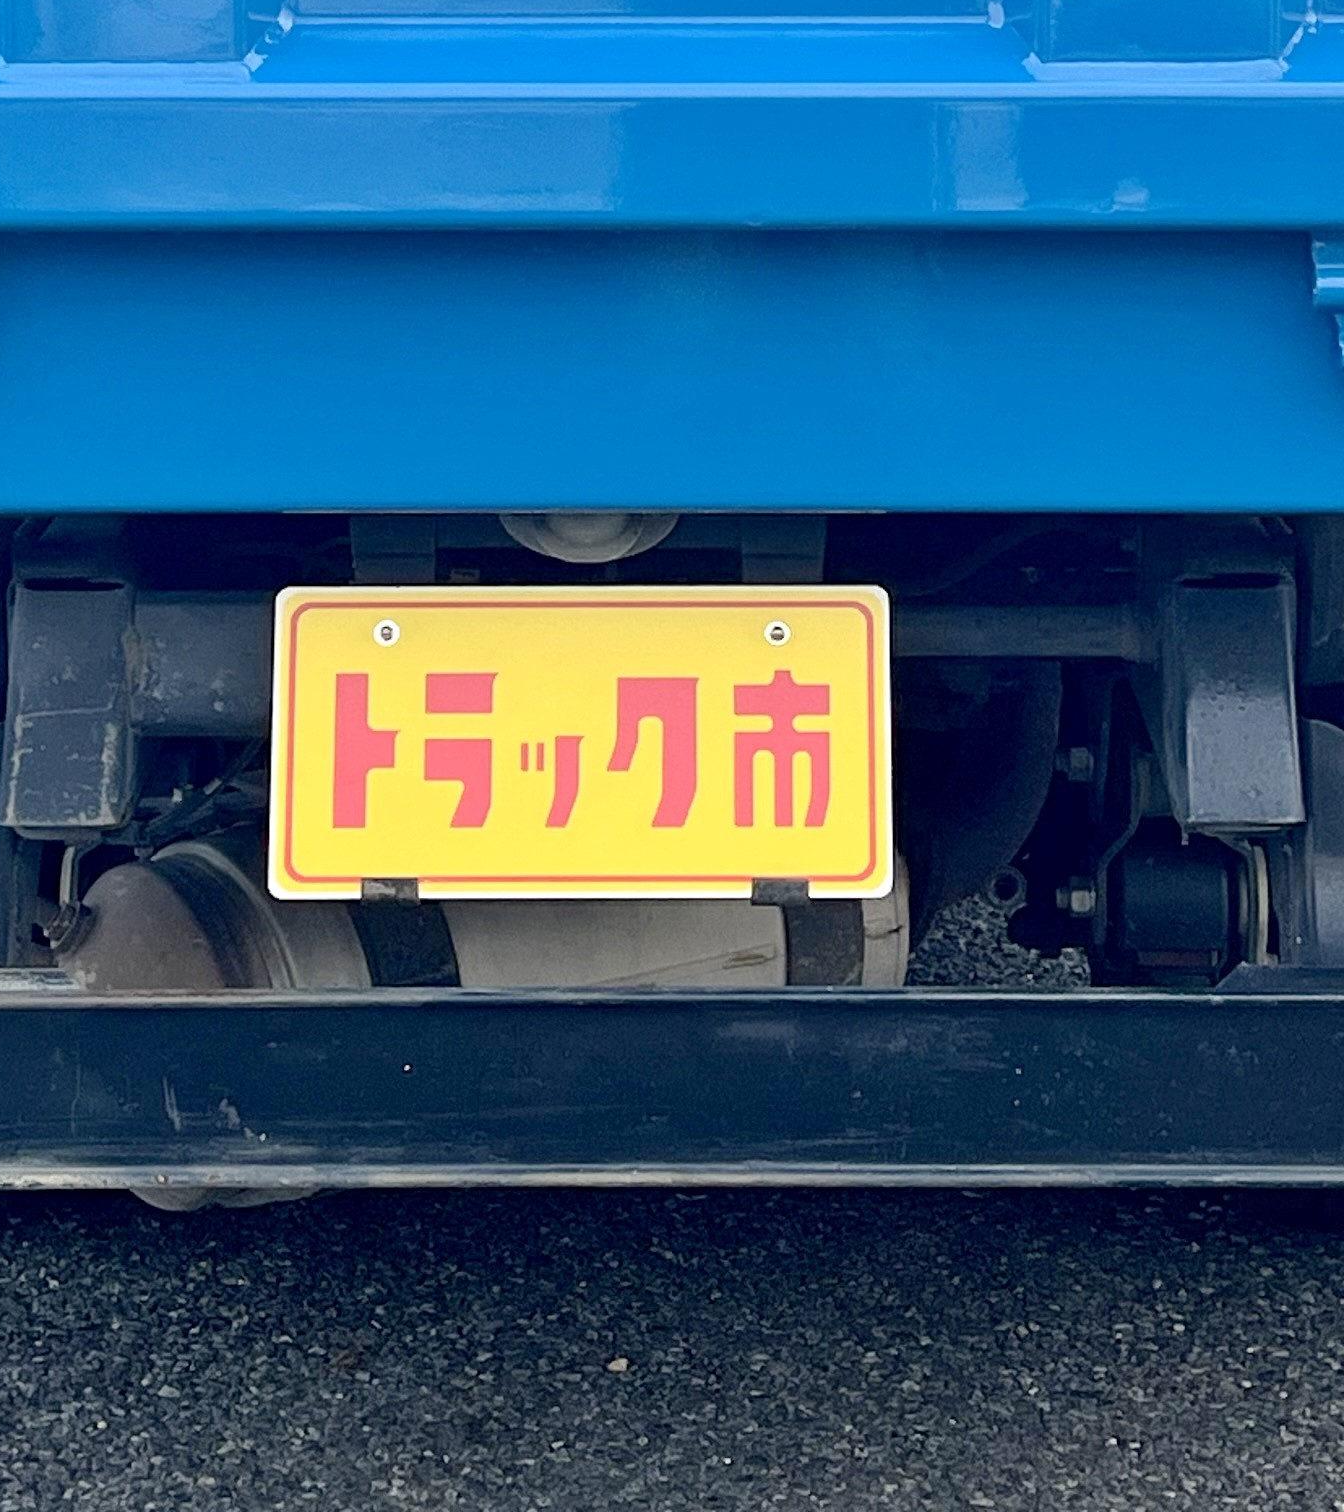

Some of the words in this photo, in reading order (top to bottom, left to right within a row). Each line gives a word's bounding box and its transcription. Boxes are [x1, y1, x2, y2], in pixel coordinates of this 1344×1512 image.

[332, 669, 831, 829] トラック市
